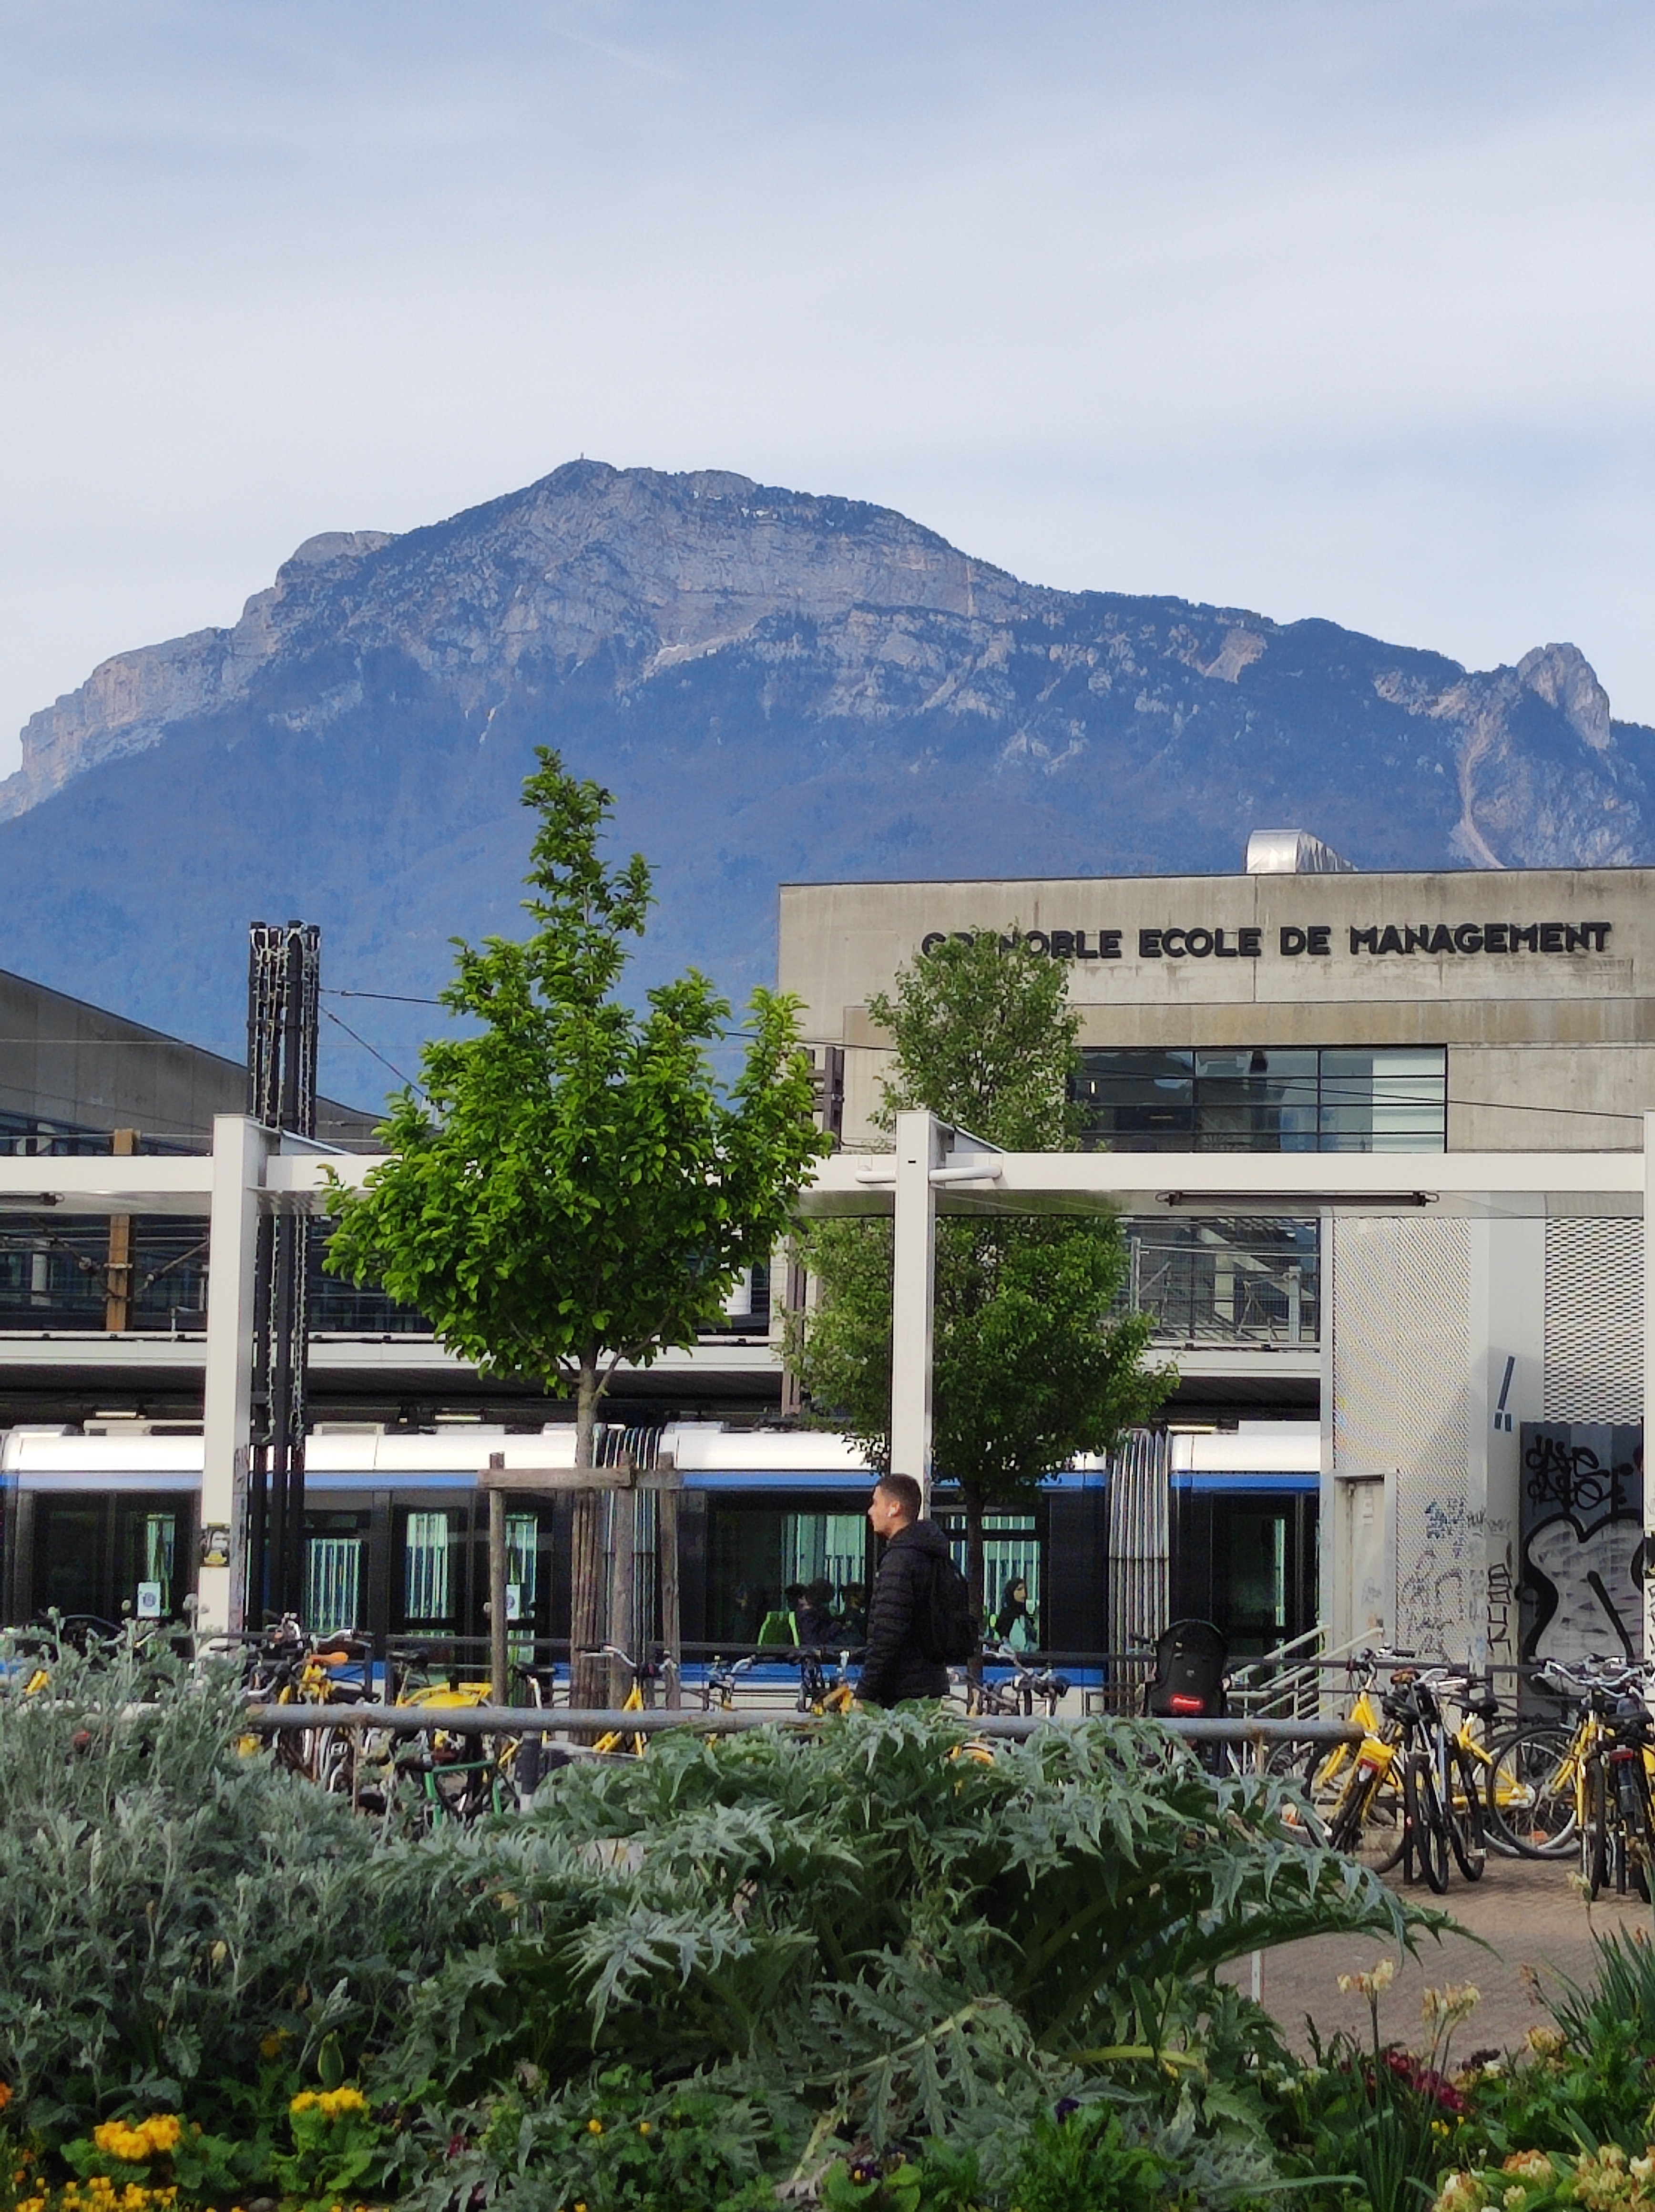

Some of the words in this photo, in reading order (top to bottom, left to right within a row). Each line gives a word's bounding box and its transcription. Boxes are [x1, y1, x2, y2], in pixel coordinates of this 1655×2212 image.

[1139, 928, 1262, 957] ECOLE
[1280, 926, 1331, 954] DE
[1349, 922, 1611, 954] MANAGEMENT
